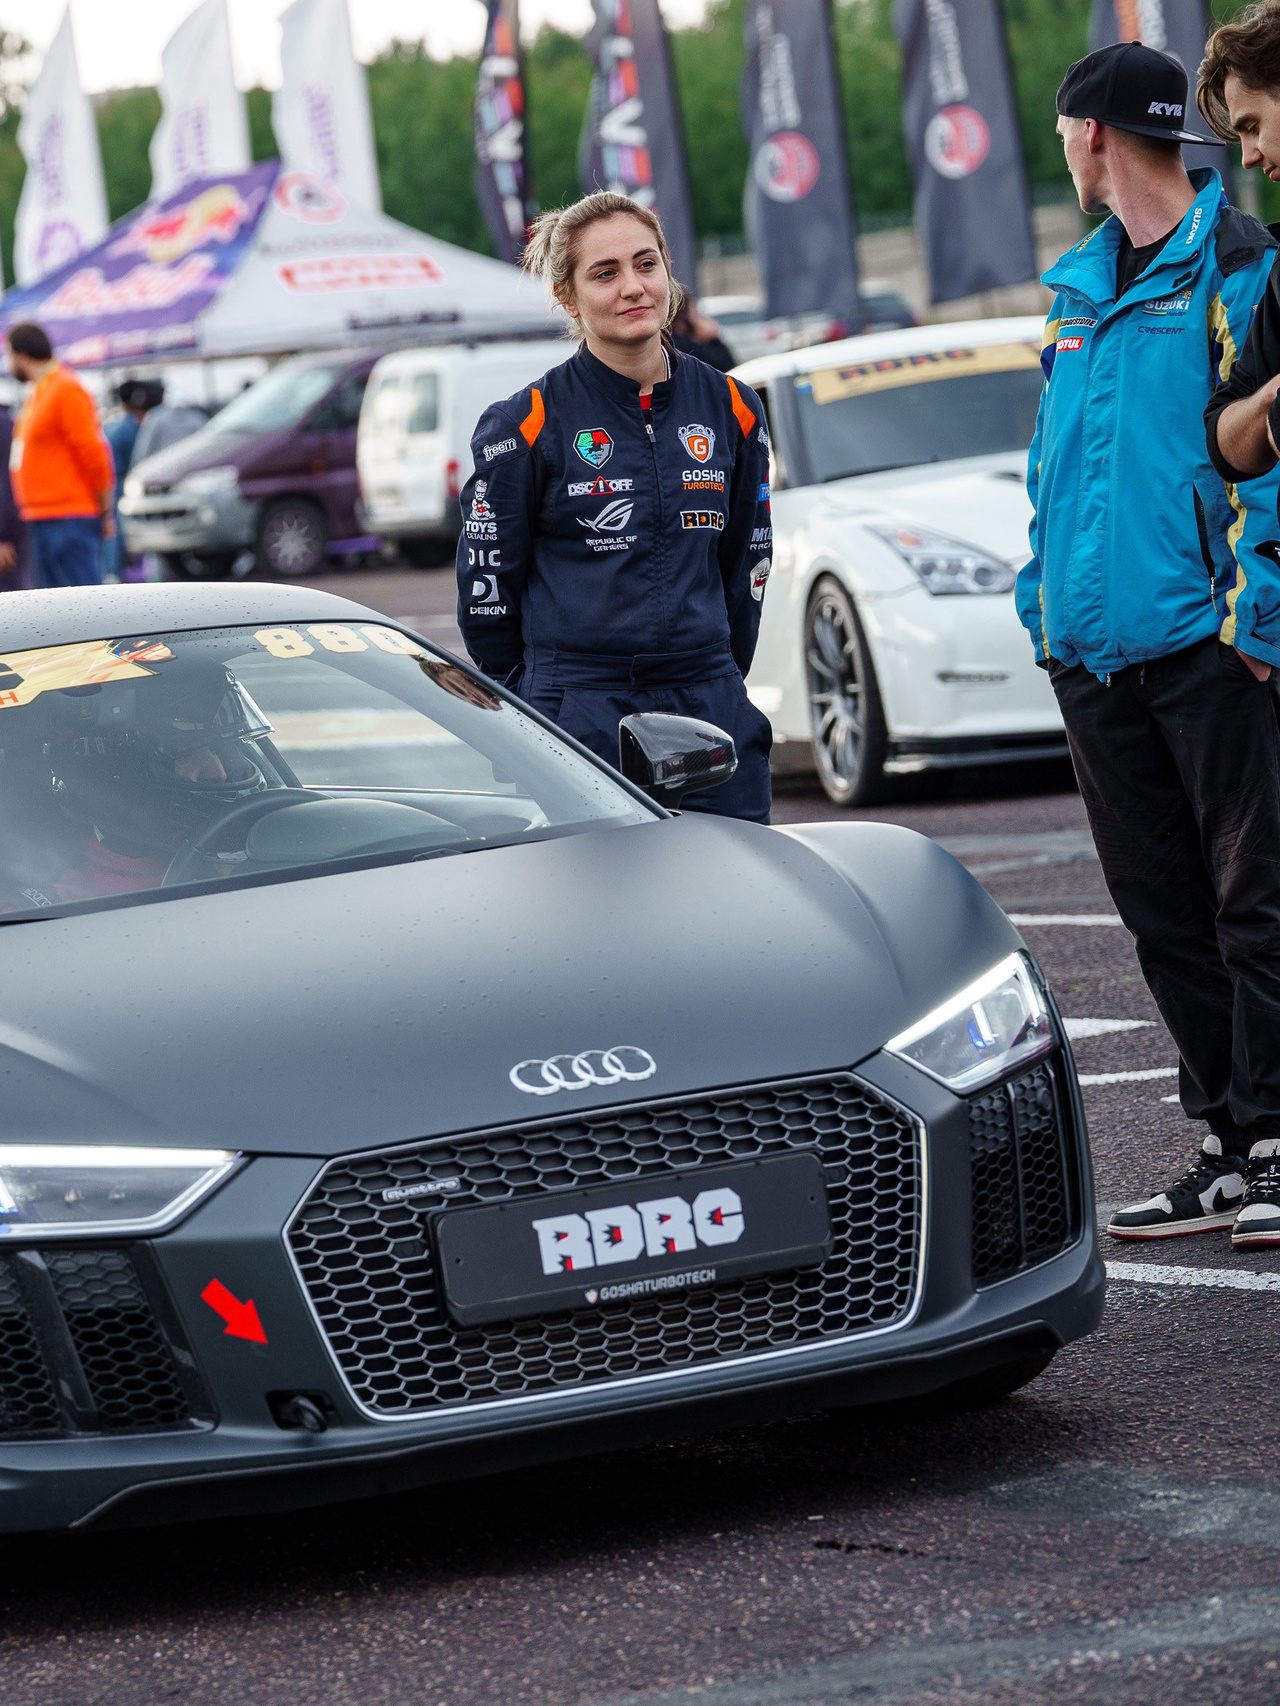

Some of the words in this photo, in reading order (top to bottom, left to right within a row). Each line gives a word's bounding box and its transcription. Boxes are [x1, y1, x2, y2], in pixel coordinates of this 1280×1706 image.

[1185, 207, 1203, 245] SUZUKI
[1144, 300, 1190, 310] SUZUKI
[1137, 325, 1186, 335] CRESCENT
[483, 438, 517, 461] freem
[682, 469, 725, 483] GOSHA
[465, 521, 497, 533] TOYS
[585, 536, 625, 547] REPUBLIC
[469, 605, 507, 615] DEIKIN
[253, 624, 422, 659] 880
[532, 1187, 745, 1276] RDRC
[600, 1268, 716, 1300] GOSHATURBOTECH
